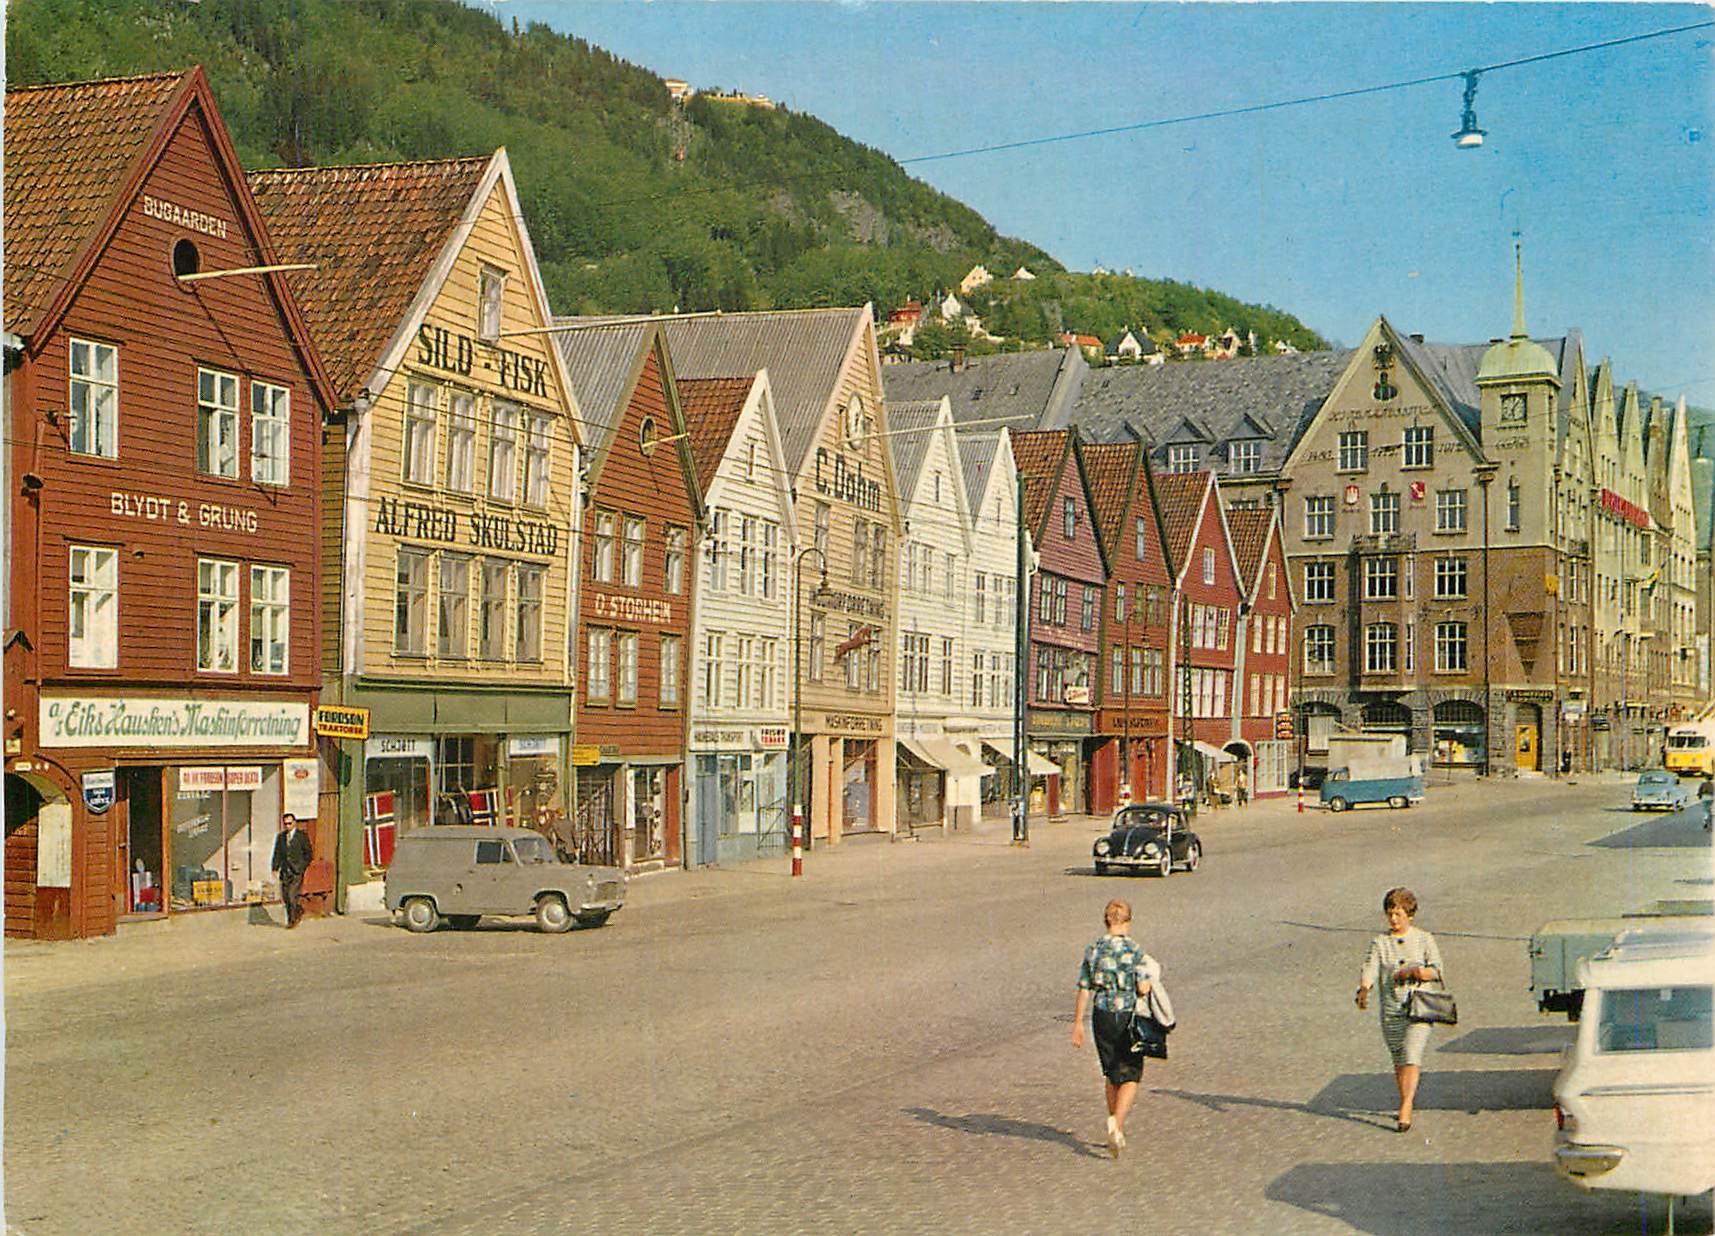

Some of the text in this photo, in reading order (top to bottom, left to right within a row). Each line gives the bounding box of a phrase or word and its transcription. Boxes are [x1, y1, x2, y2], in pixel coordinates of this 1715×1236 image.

[416, 323, 473, 377] SILD
[499, 348, 550, 399] FISK
[111, 491, 258, 534] BLYDT & GRUNG
[375, 496, 559, 556] ALFRED SKULSTAD
